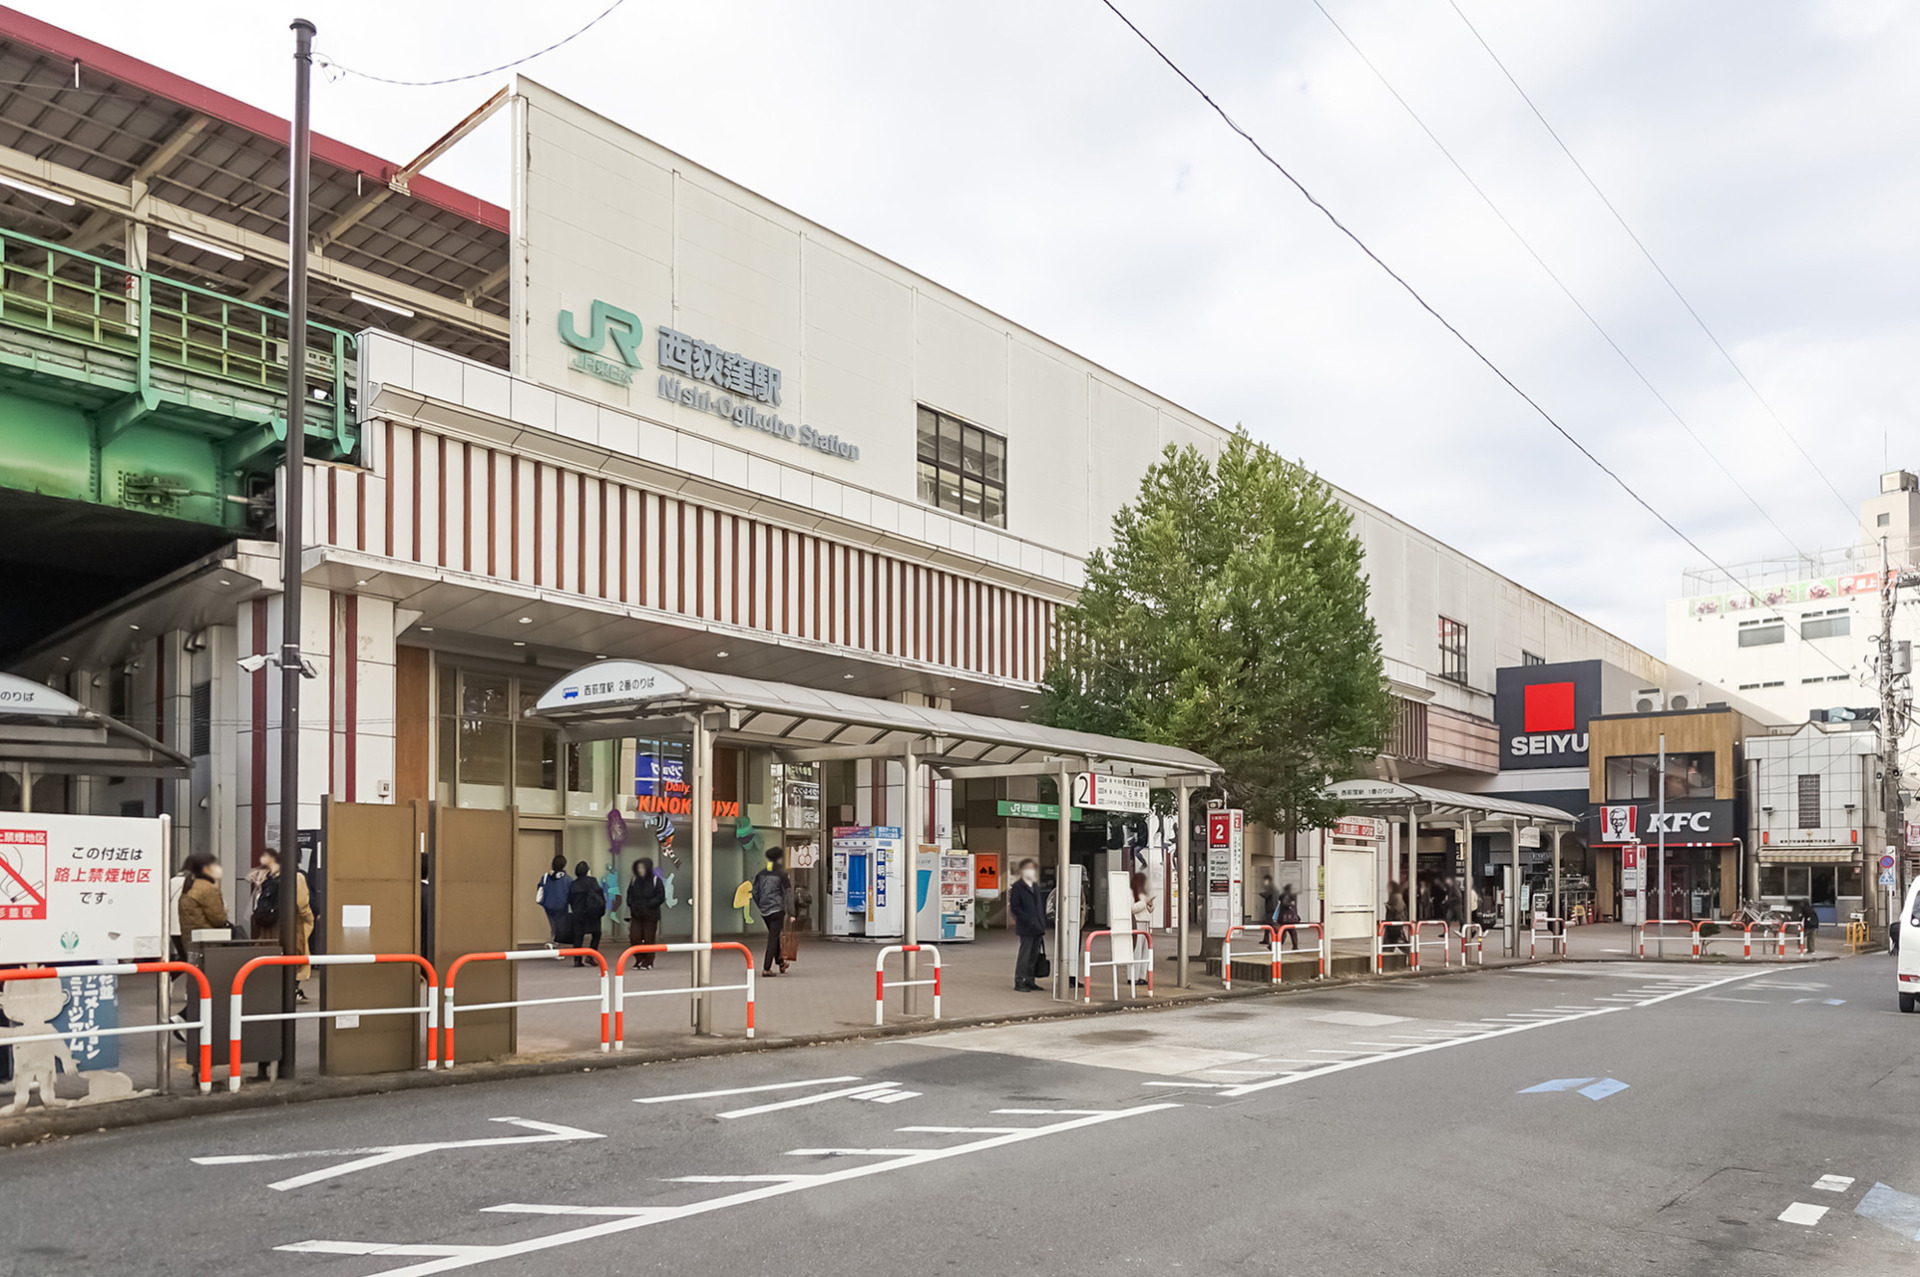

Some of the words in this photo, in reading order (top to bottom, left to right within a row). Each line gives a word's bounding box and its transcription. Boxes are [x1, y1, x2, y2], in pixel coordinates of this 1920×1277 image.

[559, 299, 643, 369] JR
[658, 325, 781, 406] 西荻窪駅
[658, 374, 797, 440] Nishi-Ogikubo
[800, 423, 860, 461] Station
[584, 681, 615, 696] 西荻窪駅
[618, 676, 655, 691] 2番のりば
[0, 691, 35, 702] のりば
[1511, 733, 1589, 756] SEIYU
[665, 781, 690, 796] Daily
[1079, 776, 1088, 804] 2
[638, 795, 739, 817] KINOKIYA
[1216, 824, 1224, 839] 2
[1646, 812, 1712, 833] KFC
[0, 832, 45, 843] 禁煙地区
[72, 847, 143, 860] この付近は
[1628, 854, 1633, 864] 1
[54, 867, 152, 883] 路上禁煙地区
[80, 892, 113, 904] です。
